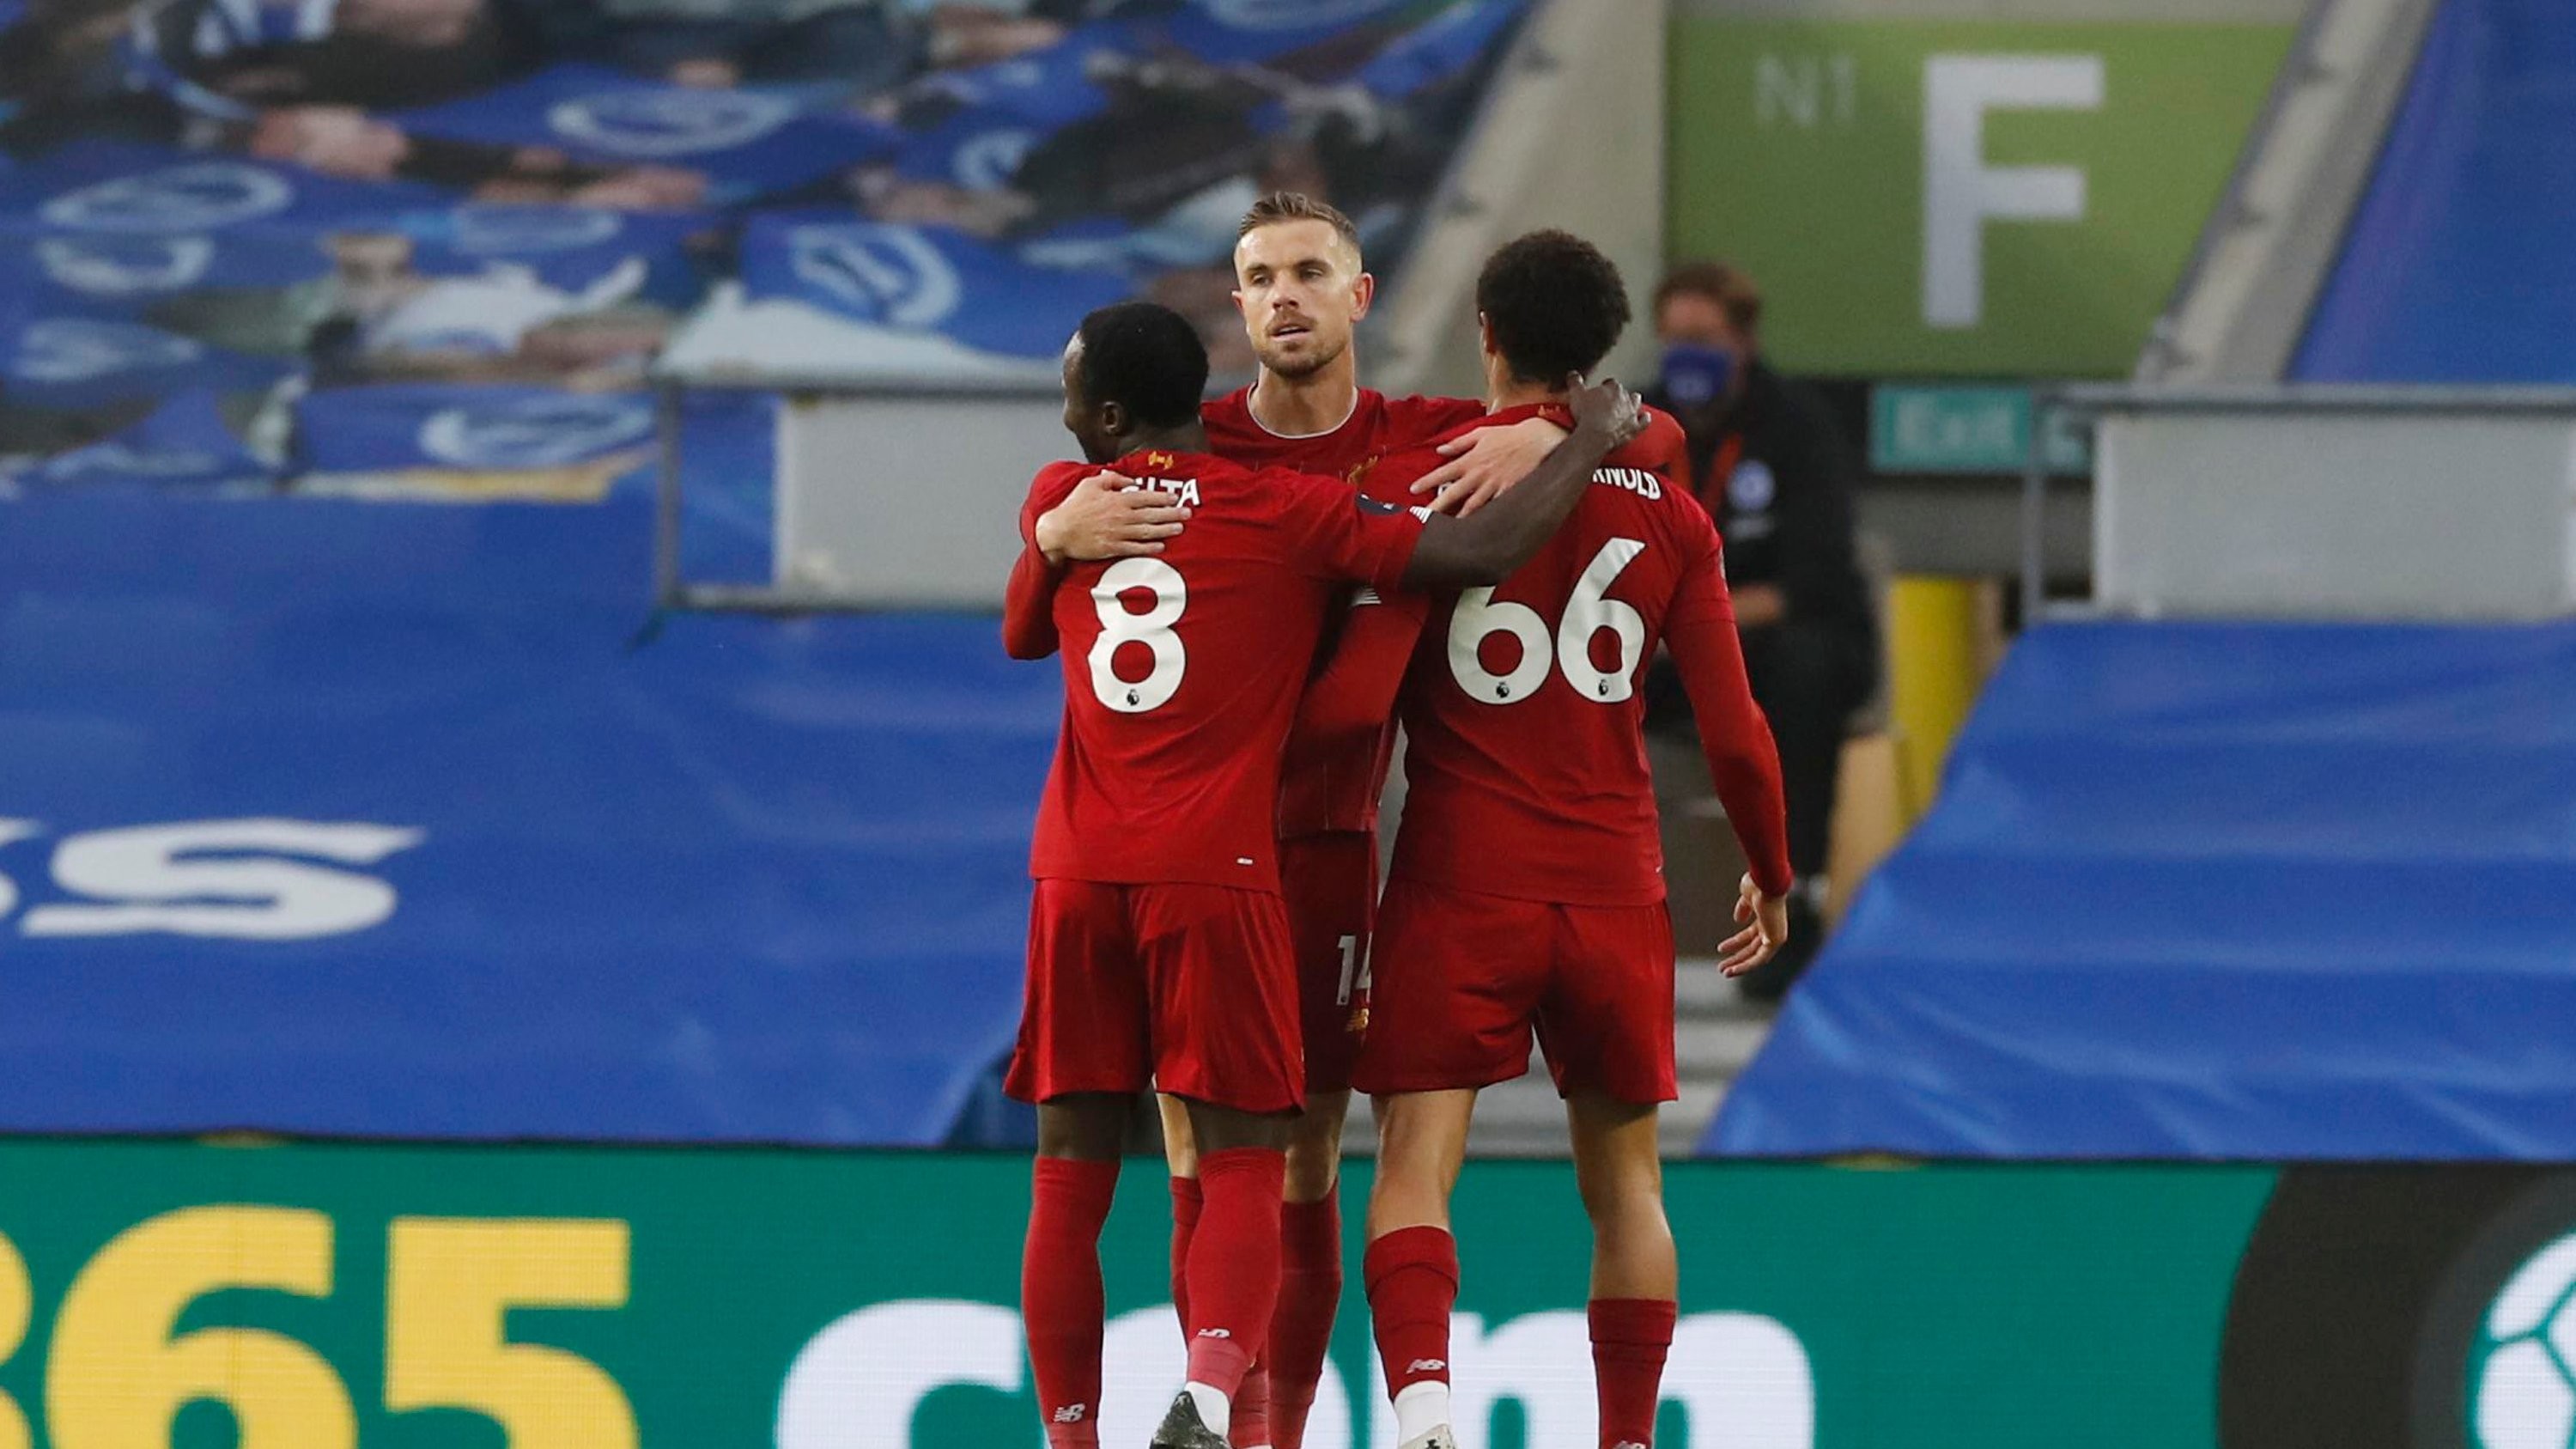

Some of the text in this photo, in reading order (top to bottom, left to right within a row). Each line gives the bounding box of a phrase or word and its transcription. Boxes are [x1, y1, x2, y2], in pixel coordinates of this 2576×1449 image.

[1756, 55, 1854, 125] N1
[1923, 55, 2105, 326] F
[1087, 557, 1188, 713] 8
[1448, 537, 1646, 704] 66
[0, 818, 424, 940] S
[0, 1203, 641, 1449] 65
